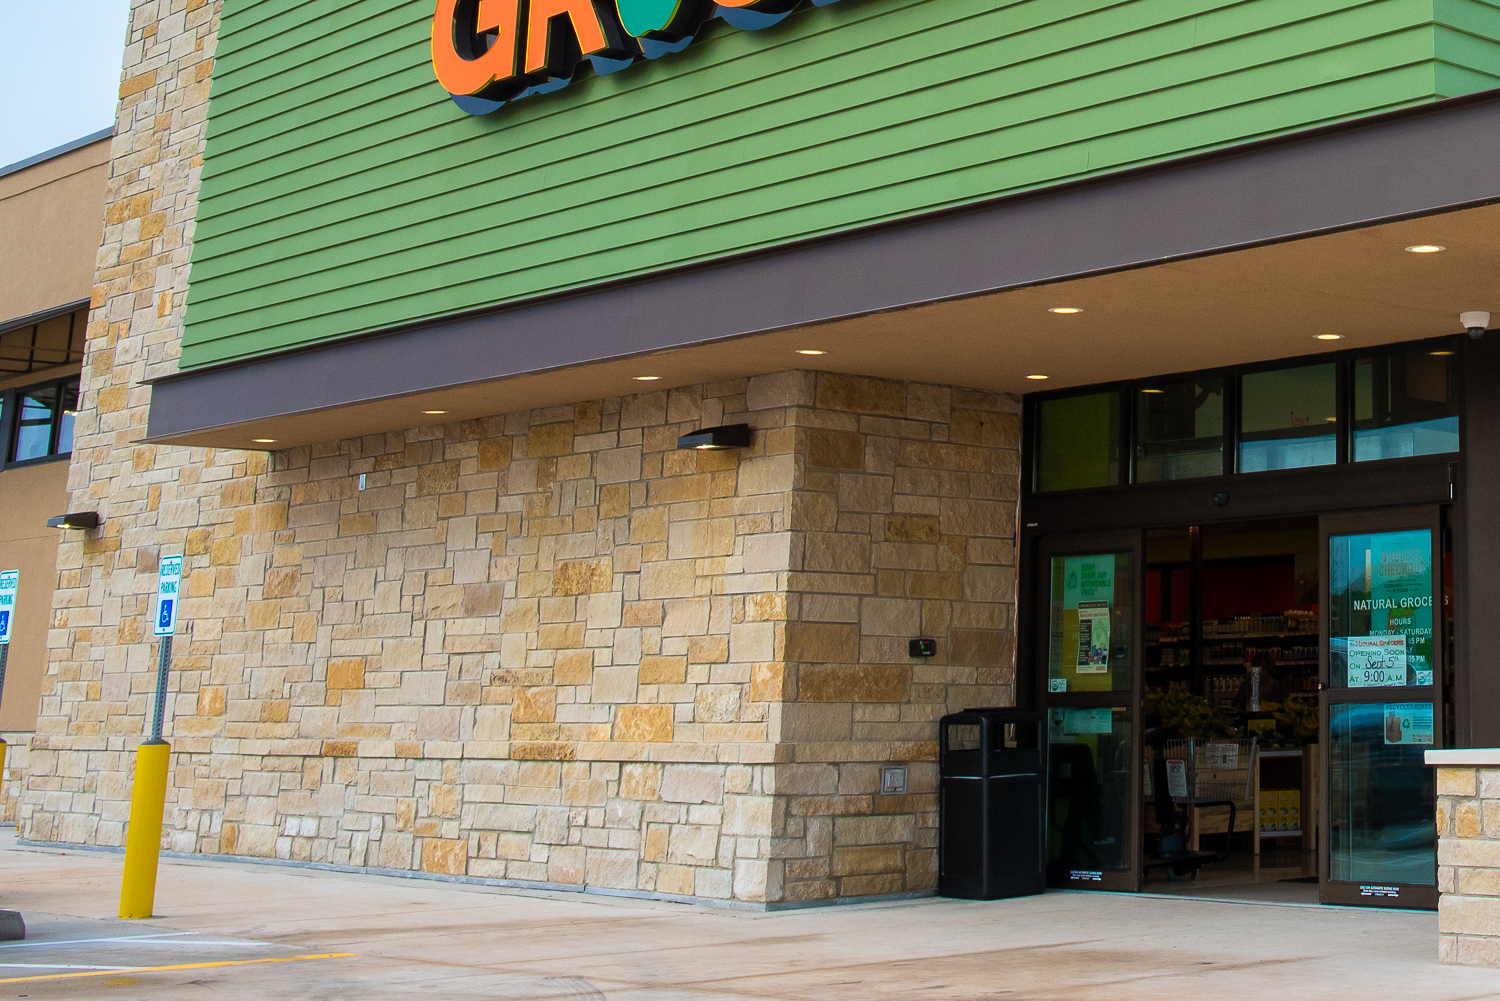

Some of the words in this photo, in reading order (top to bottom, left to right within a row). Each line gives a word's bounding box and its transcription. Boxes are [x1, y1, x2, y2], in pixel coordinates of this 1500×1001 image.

[1381, 549, 1423, 563] BAGLESS
[160, 562, 181, 576] RESERVED
[1378, 562, 1425, 577] CHECKOUT
[1081, 572, 1096, 580] EVERY
[1097, 571, 1107, 579] DAY
[160, 580, 178, 594] PARKING
[1081, 579, 1112, 588] AFFORDABLE
[1353, 598, 1398, 611] NATURAL
[1400, 595, 1449, 608] GROCES
[1389, 617, 1412, 626] HOURS
[1400, 627, 1432, 636] SATURDAY
[1415, 636, 1426, 645] PM
[1349, 649, 1382, 658] OPENING
[1383, 648, 1405, 656] SOON
[1415, 654, 1426, 663] PM
[1349, 662, 1361, 670] ON
[1363, 670, 1385, 683] 9:00
[1386, 703, 1414, 711] RECYCLED
